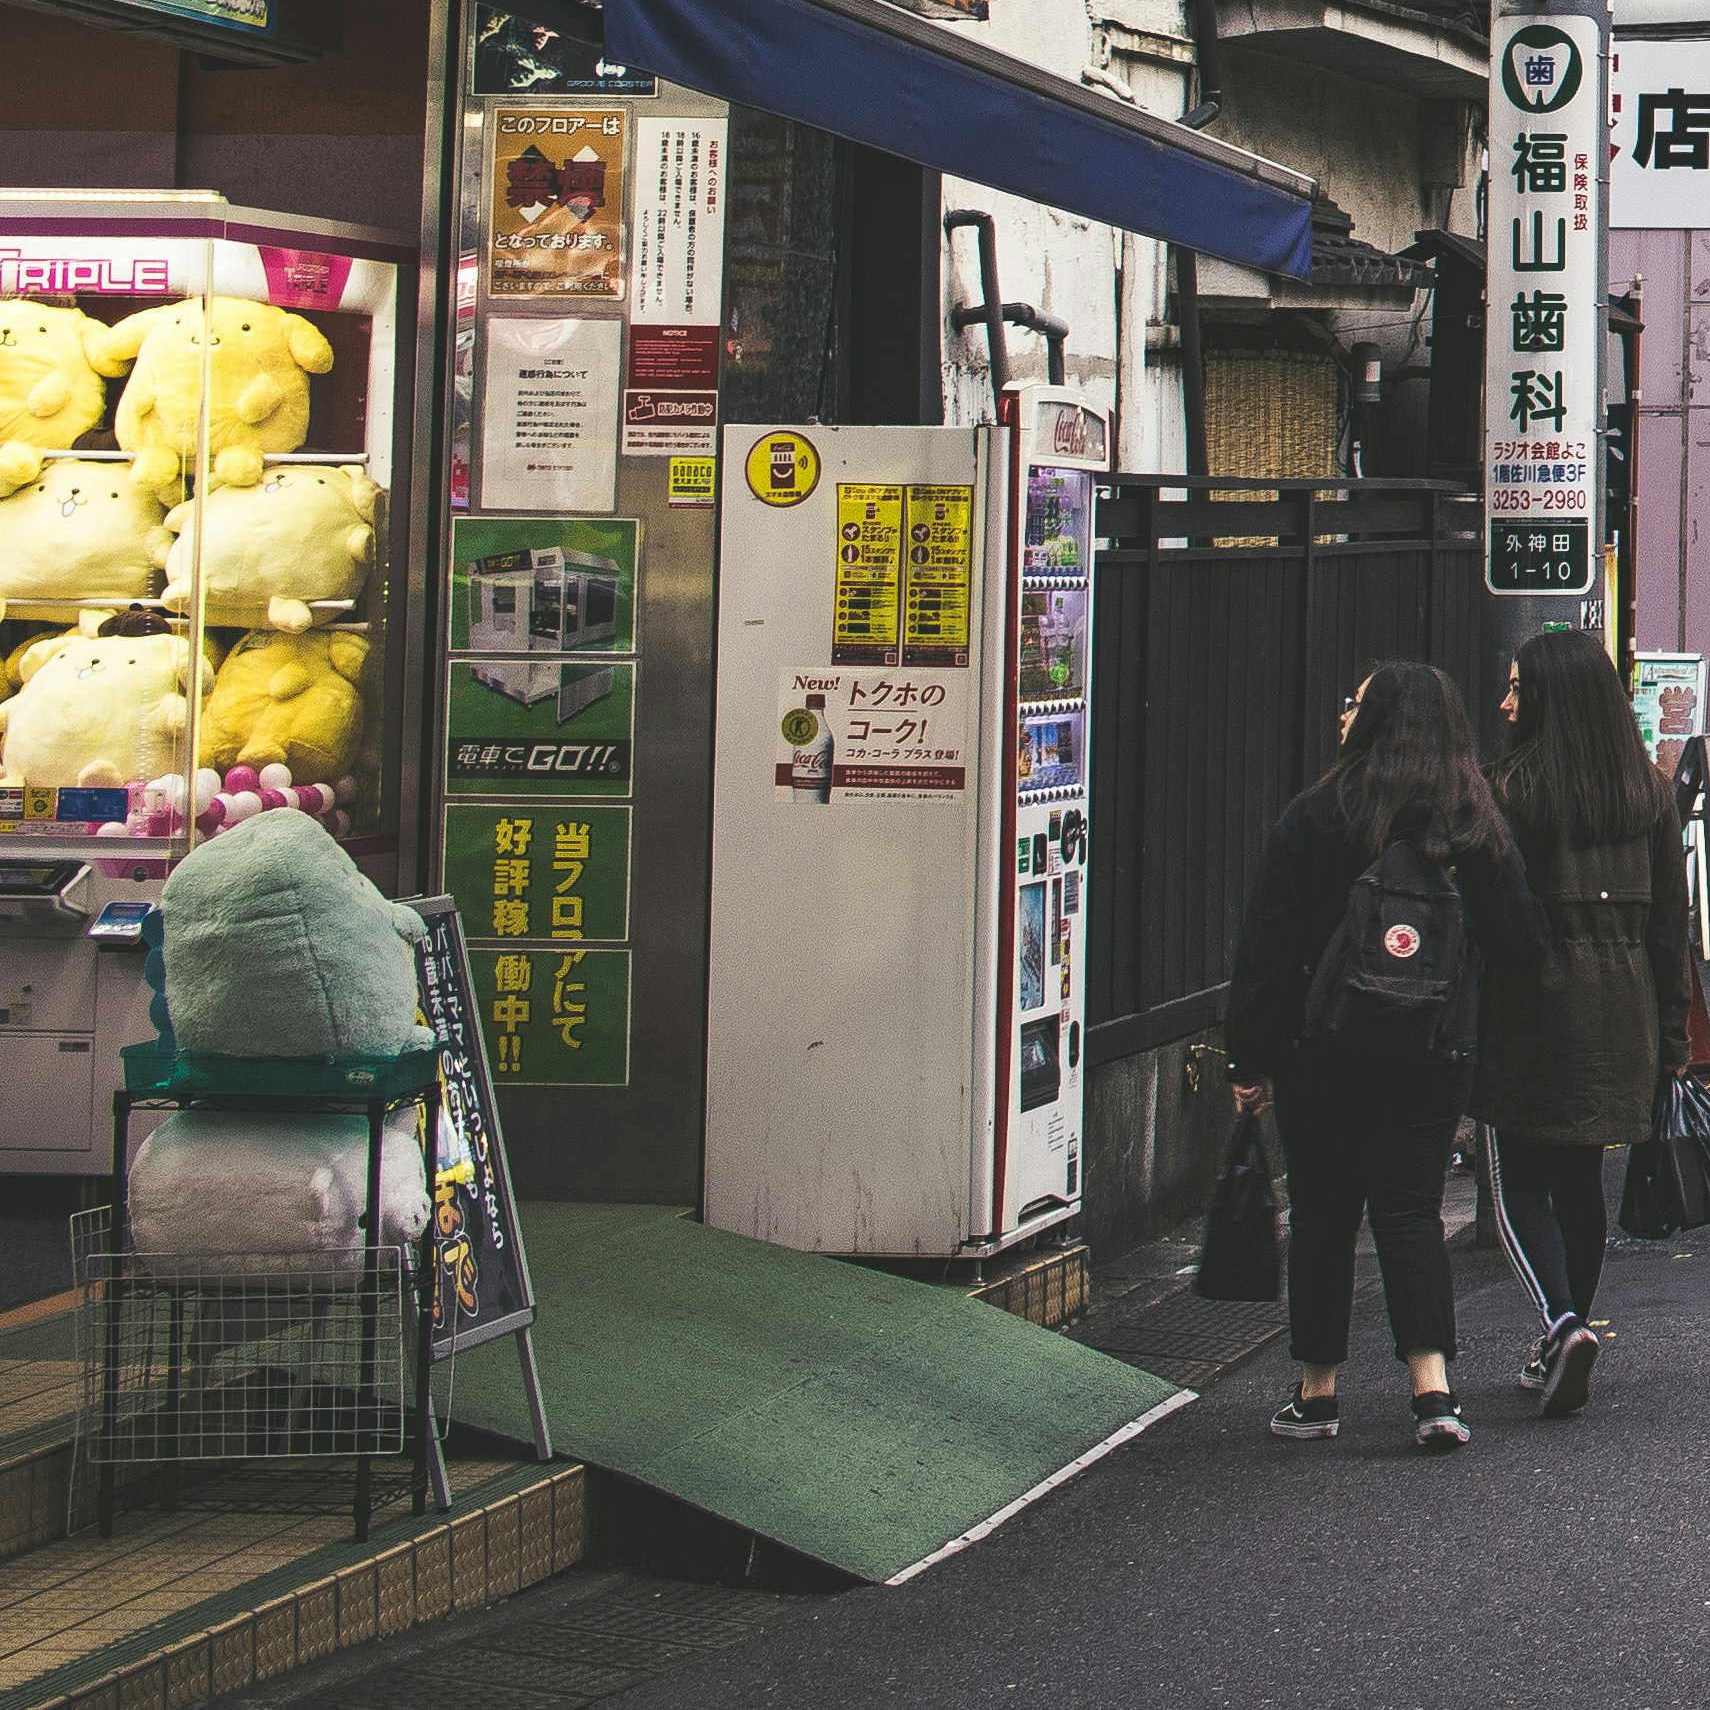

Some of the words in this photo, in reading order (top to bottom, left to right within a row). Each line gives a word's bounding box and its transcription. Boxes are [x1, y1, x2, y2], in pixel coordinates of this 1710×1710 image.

[1524, 53, 1555, 86] 歯
[500, 115, 622, 137] このフロアーは
[705, 140, 720, 215] お客様へのお願い
[1573, 152, 1589, 232] 保険取扱
[493, 231, 614, 251] となっております。
[1510, 132, 1568, 435] 福山歯科
[662, 328, 689, 338] NOTICE
[1492, 440, 1587, 462] ラジオ会館よこ
[672, 464, 713, 479] nanaco
[1492, 463, 1587, 486] 1階佐川急便3F
[1492, 489, 1587, 513] 3253-2980
[1505, 534, 1571, 556] 外神田
[1509, 562, 1572, 583] 1-10
[792, 675, 841, 691] New!
[849, 679, 947, 708] トクホの
[846, 718, 929, 745] コーク!
[845, 748, 900, 760] コカ・コーラ
[904, 748, 934, 760] プラス
[492, 817, 533, 1073] 好評稼働中!!
[551, 822, 592, 1050] 当フロアにて
